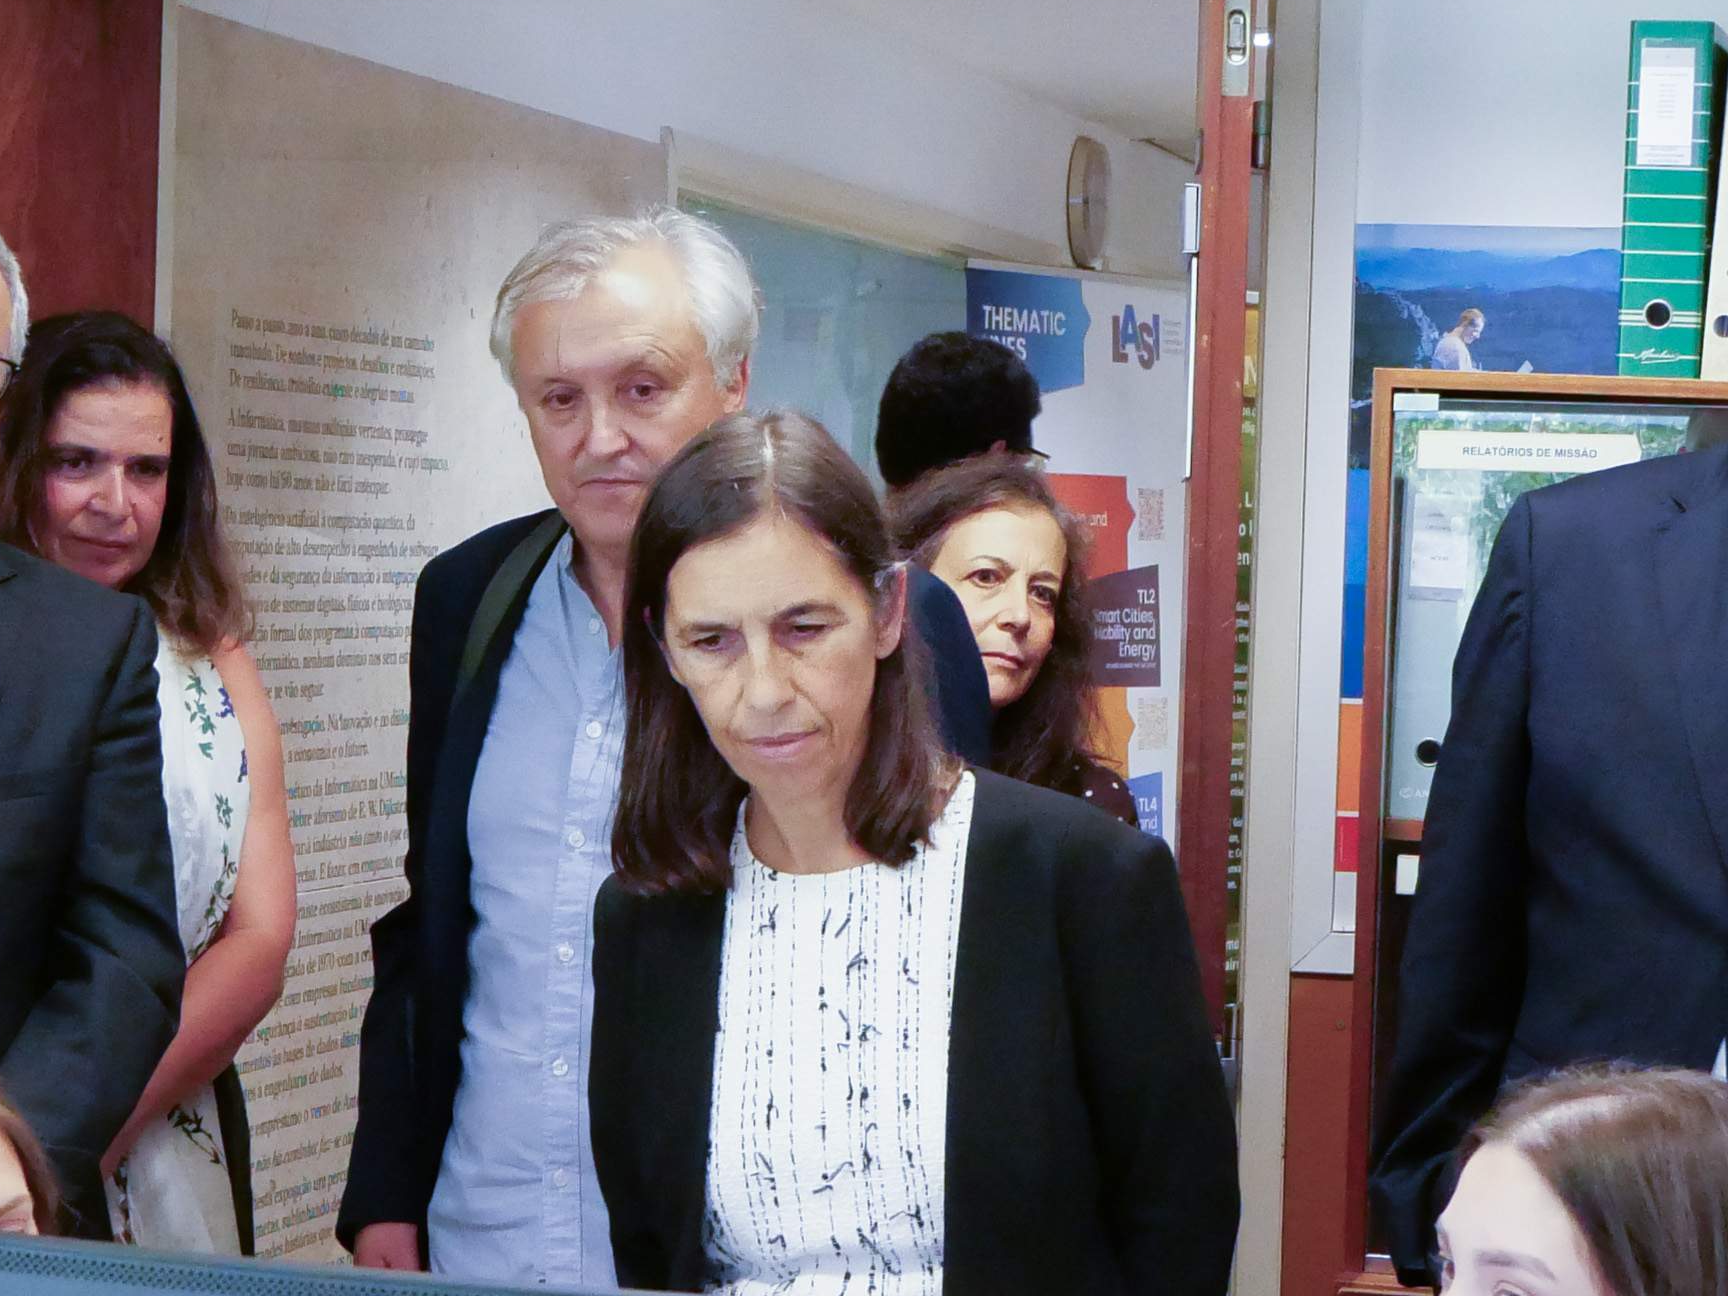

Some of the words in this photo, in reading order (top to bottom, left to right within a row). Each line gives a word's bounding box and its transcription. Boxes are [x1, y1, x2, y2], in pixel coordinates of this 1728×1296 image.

[982, 305, 1066, 336] THEMATIC
[1111, 304, 1160, 370] LASI
[1462, 445, 1534, 459] RELATÓRIOS
[1536, 448, 1551, 459] DE
[1137, 588, 1156, 604] TL2
[1122, 607, 1156, 625] Cities,
[270, 622, 297, 642] formal
[1133, 626, 1156, 640] and
[1119, 642, 1156, 662] Energy
[1138, 797, 1157, 812] TL4
[317, 1033, 340, 1055] dados
